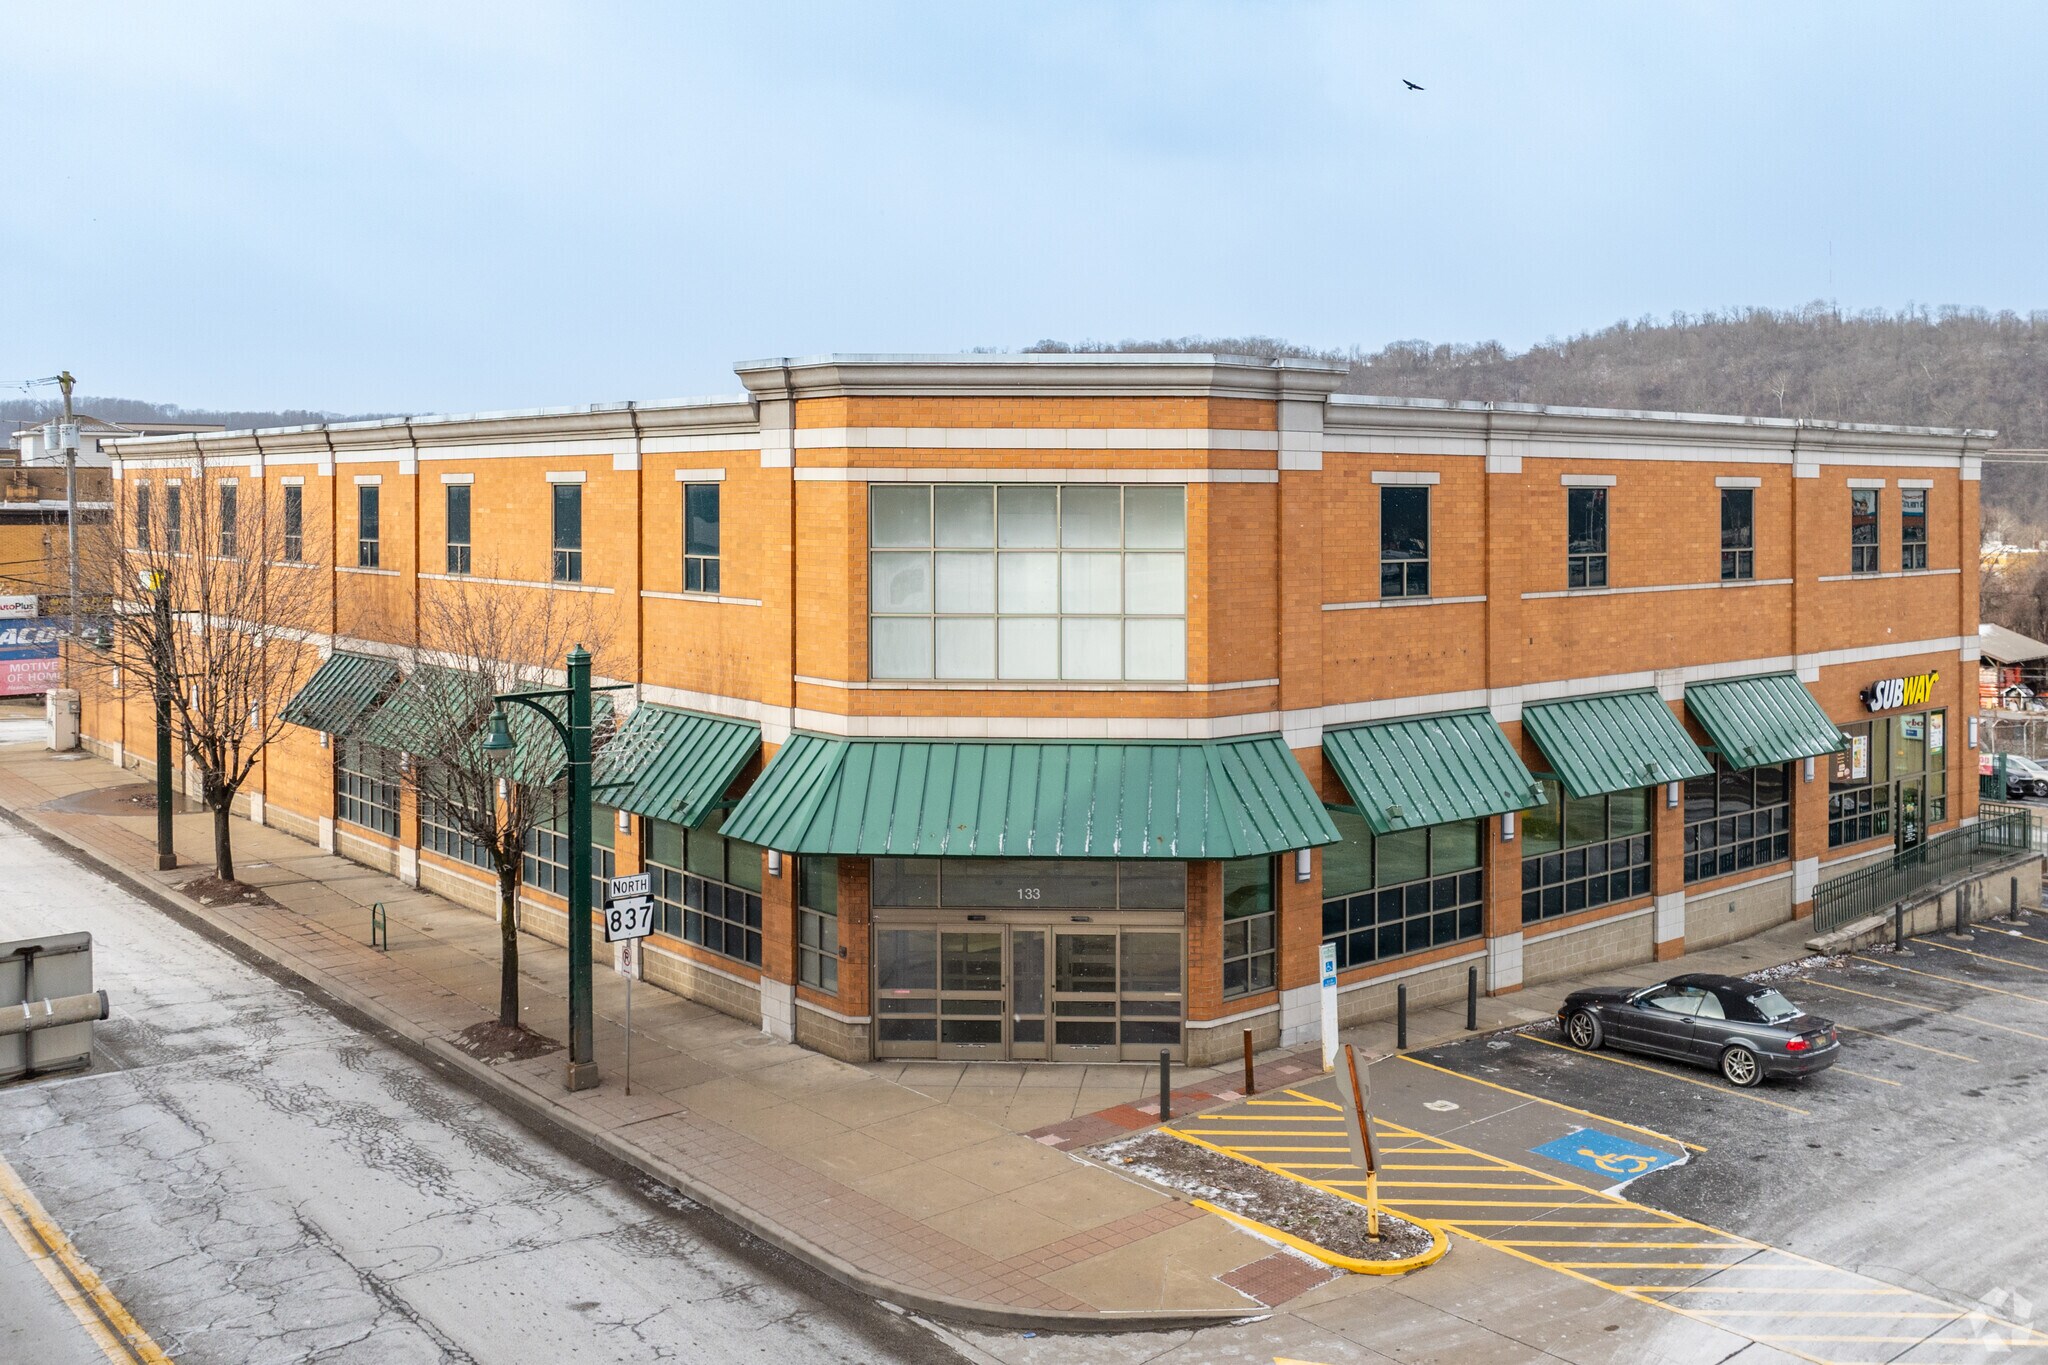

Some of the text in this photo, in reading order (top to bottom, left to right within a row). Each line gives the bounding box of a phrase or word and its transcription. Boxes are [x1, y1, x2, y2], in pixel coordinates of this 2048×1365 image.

[0, 602, 34, 611] utoPlus
[10, 661, 59, 673] MOTIVE
[7, 674, 23, 683] OF
[1870, 672, 1940, 713] SUBWAY
[613, 879, 647, 894] NORTH
[1017, 888, 1041, 900] 133
[610, 905, 651, 933] 837
